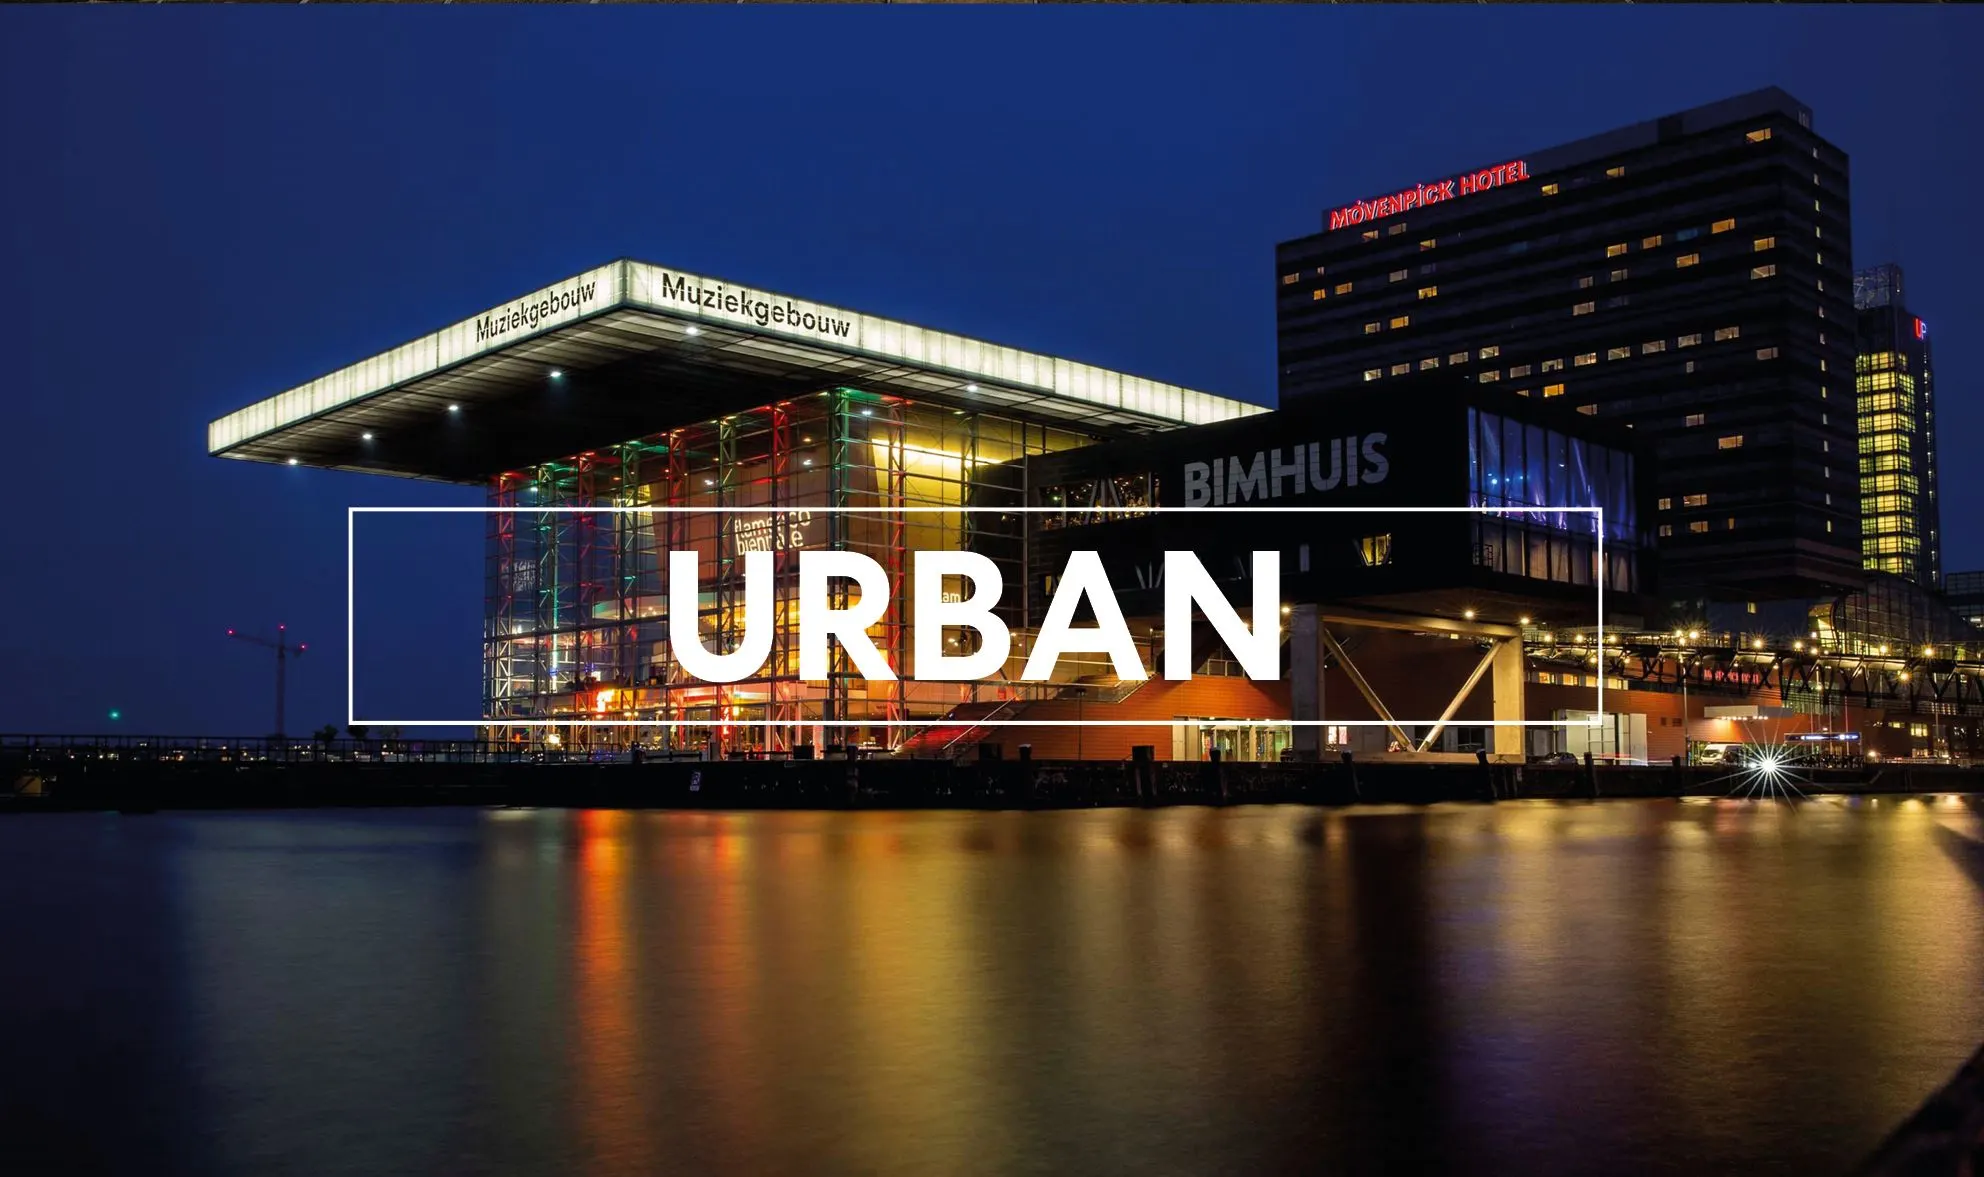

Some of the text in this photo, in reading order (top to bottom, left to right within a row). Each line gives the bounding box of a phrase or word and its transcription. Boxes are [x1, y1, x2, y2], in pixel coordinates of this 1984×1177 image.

[1460, 160, 1530, 196] HOTEL
[476, 280, 595, 343] Muziekgebouw
[662, 272, 850, 338] Muziekgebouw
[1184, 432, 1390, 509] BIMHUIS
